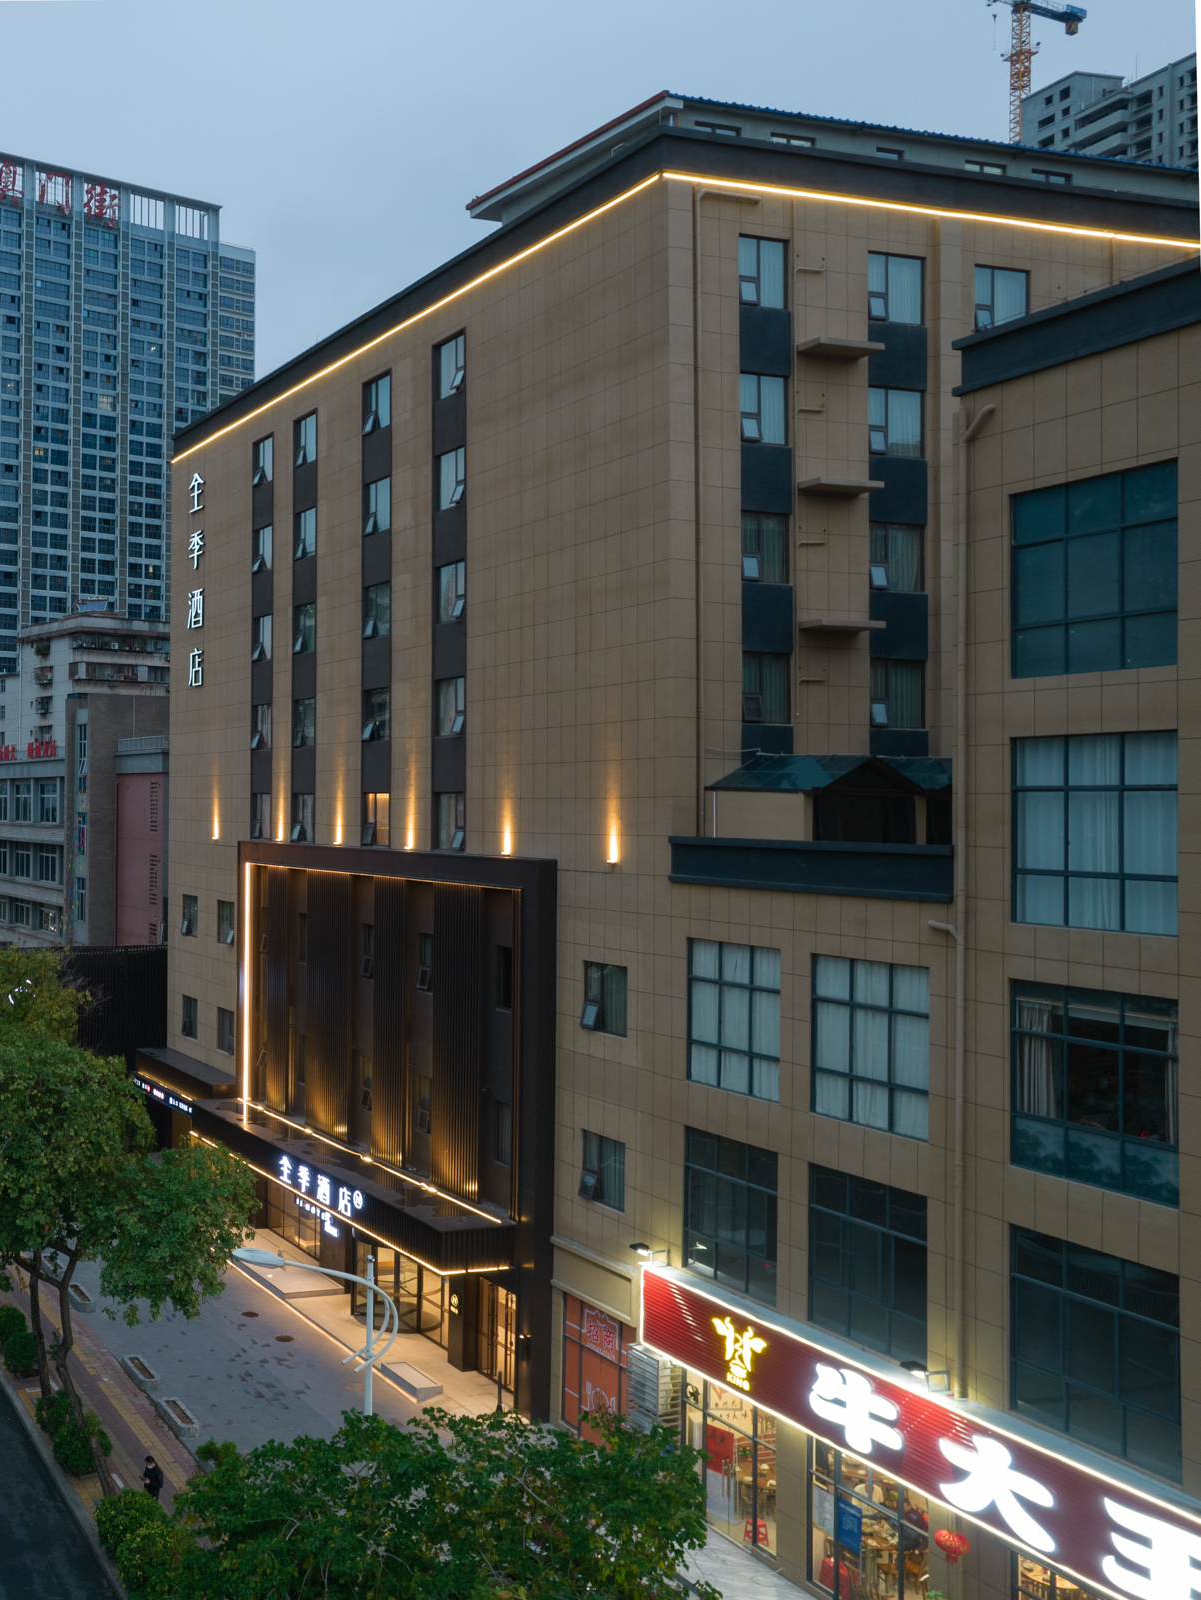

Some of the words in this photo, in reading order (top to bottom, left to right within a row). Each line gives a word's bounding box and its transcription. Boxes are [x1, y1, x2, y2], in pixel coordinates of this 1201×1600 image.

[187, 472, 205, 687] 全季酒店
[278, 1155, 352, 1217] 全季酒店
[586, 1319, 616, 1352] 招商
